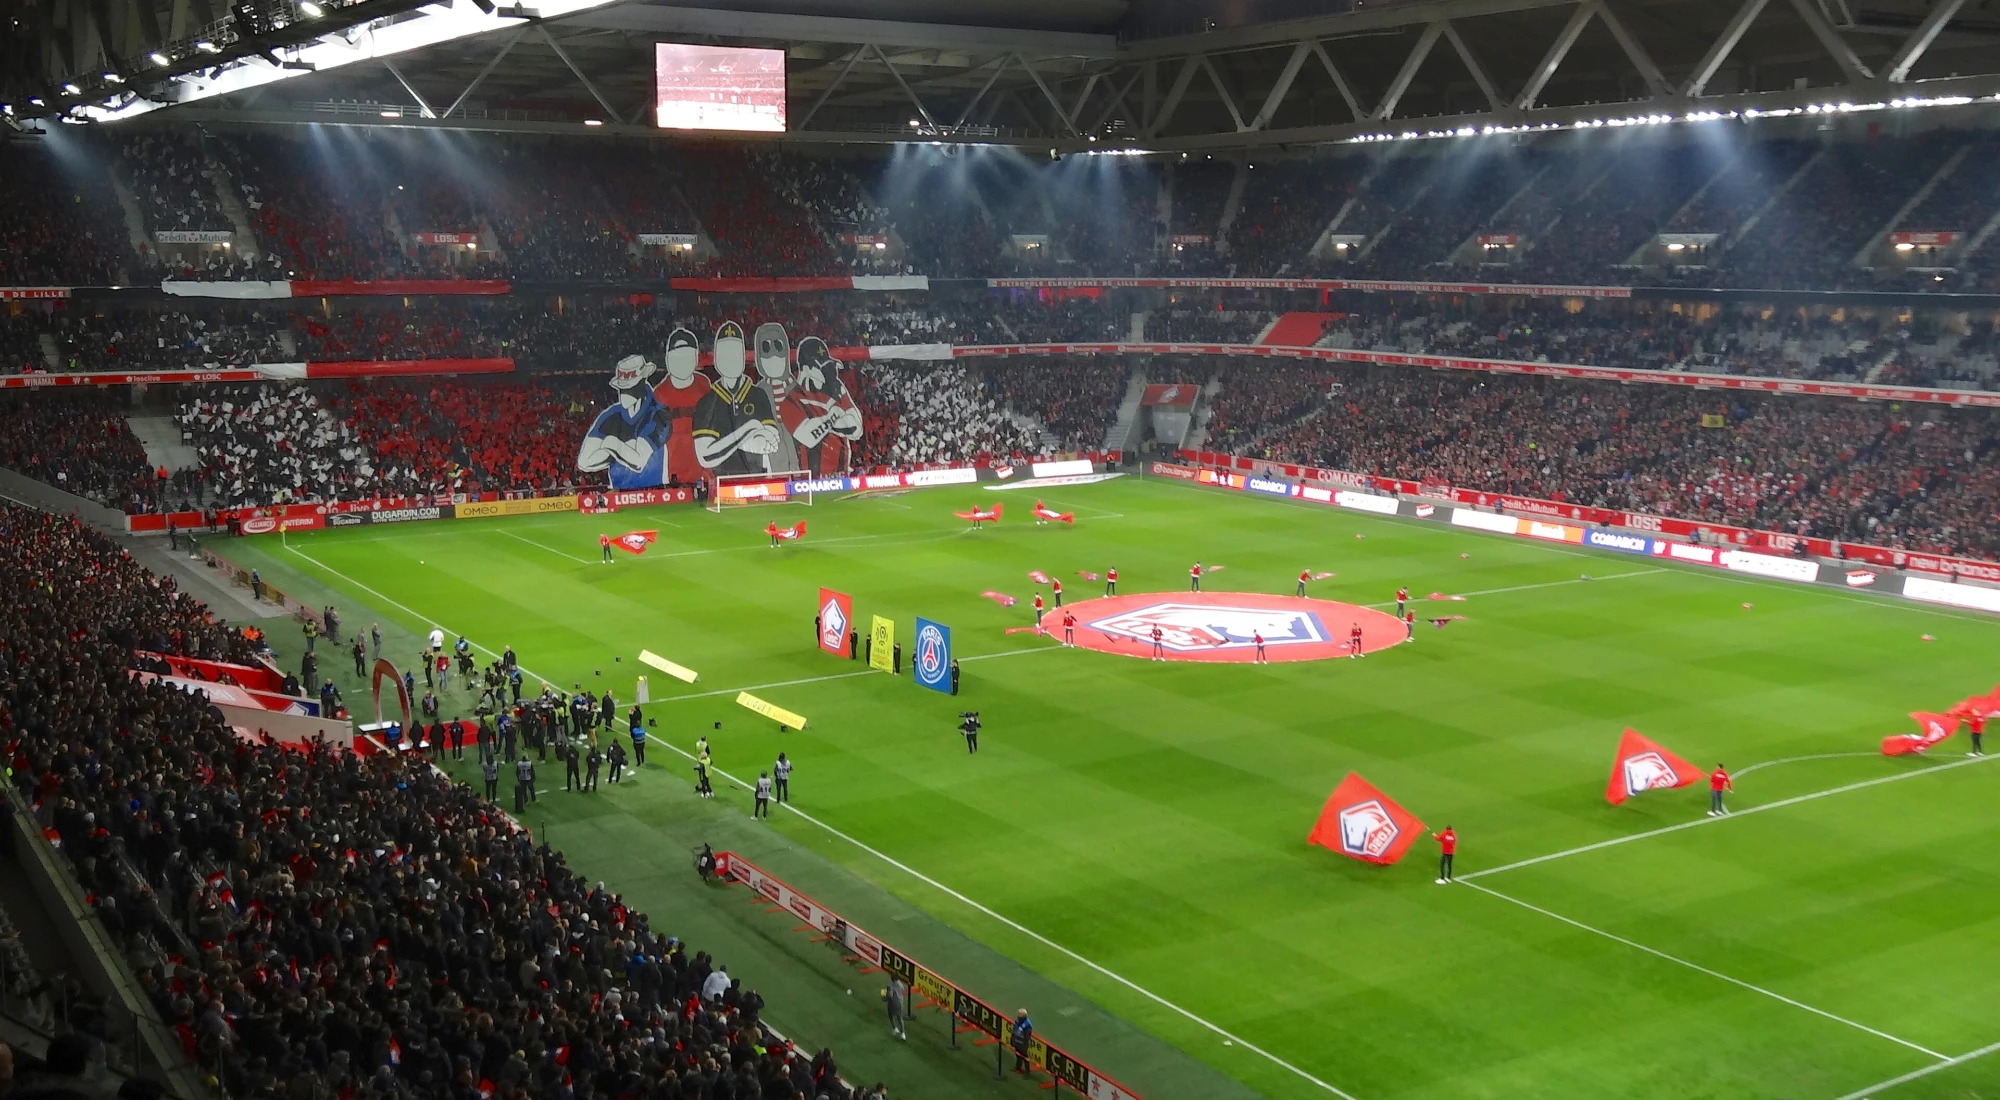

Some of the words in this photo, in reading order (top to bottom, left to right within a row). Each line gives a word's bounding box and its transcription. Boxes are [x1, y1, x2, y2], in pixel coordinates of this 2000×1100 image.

[434, 234, 460, 243] LOSC
[24, 377, 57, 387] WINAMAX
[202, 373, 221, 381] LOSC
[795, 478, 843, 493] COMARCH
[866, 474, 901, 488] WINAMAX
[1250, 479, 1287, 494] COMARCH
[615, 492, 656, 505] LOSC.fr
[371, 507, 440, 520] DUGARDIN.COM
[1625, 513, 1662, 532] LOSC
[1590, 531, 1646, 551] COMARCH
[1909, 556, 1939, 570] new
[1940, 558, 2000, 580] balance
[884, 949, 911, 977] SDI
[960, 995, 997, 1029] STPI
[1051, 1052, 1085, 1083] CRI
